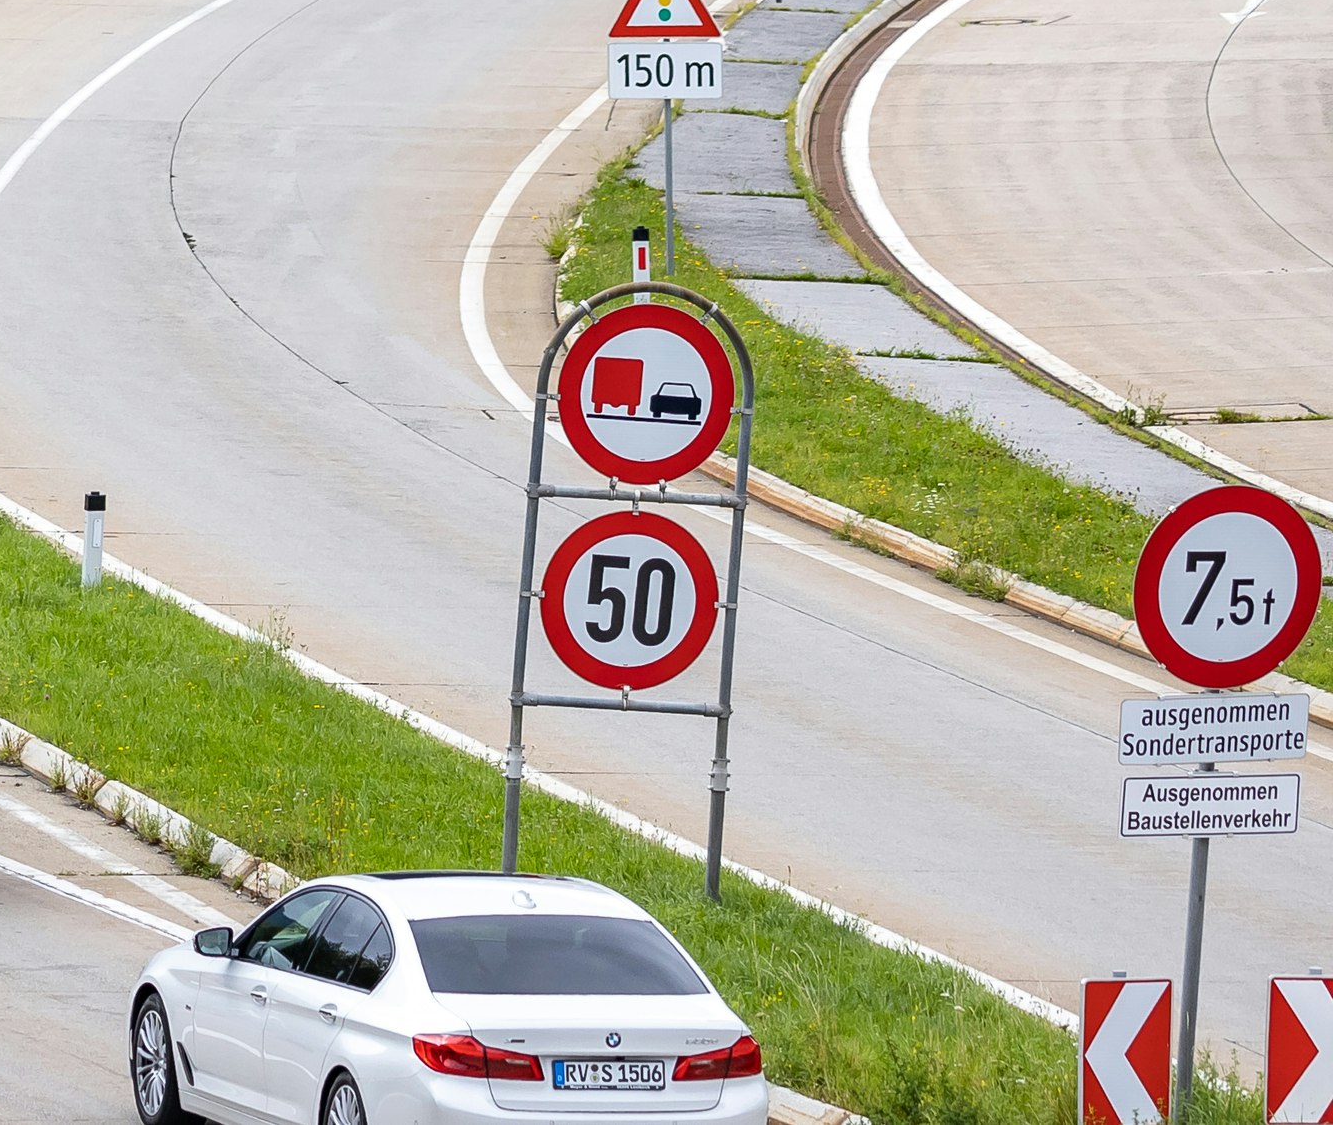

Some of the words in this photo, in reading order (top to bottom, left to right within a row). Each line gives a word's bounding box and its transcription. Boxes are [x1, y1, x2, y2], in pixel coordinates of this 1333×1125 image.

[617, 53, 674, 87] 150
[685, 61, 715, 87] m
[585, 554, 676, 646] 50
[1141, 702, 1290, 730] ausgenommen
[1122, 729, 1304, 757] Sondertransporte
[1142, 783, 1278, 806] Ausgenommen
[1127, 809, 1291, 830] Baustellenverkehr
[566, 1065, 589, 1082] RV
[601, 1065, 612, 1082] S
[618, 1065, 662, 1082] 1506
